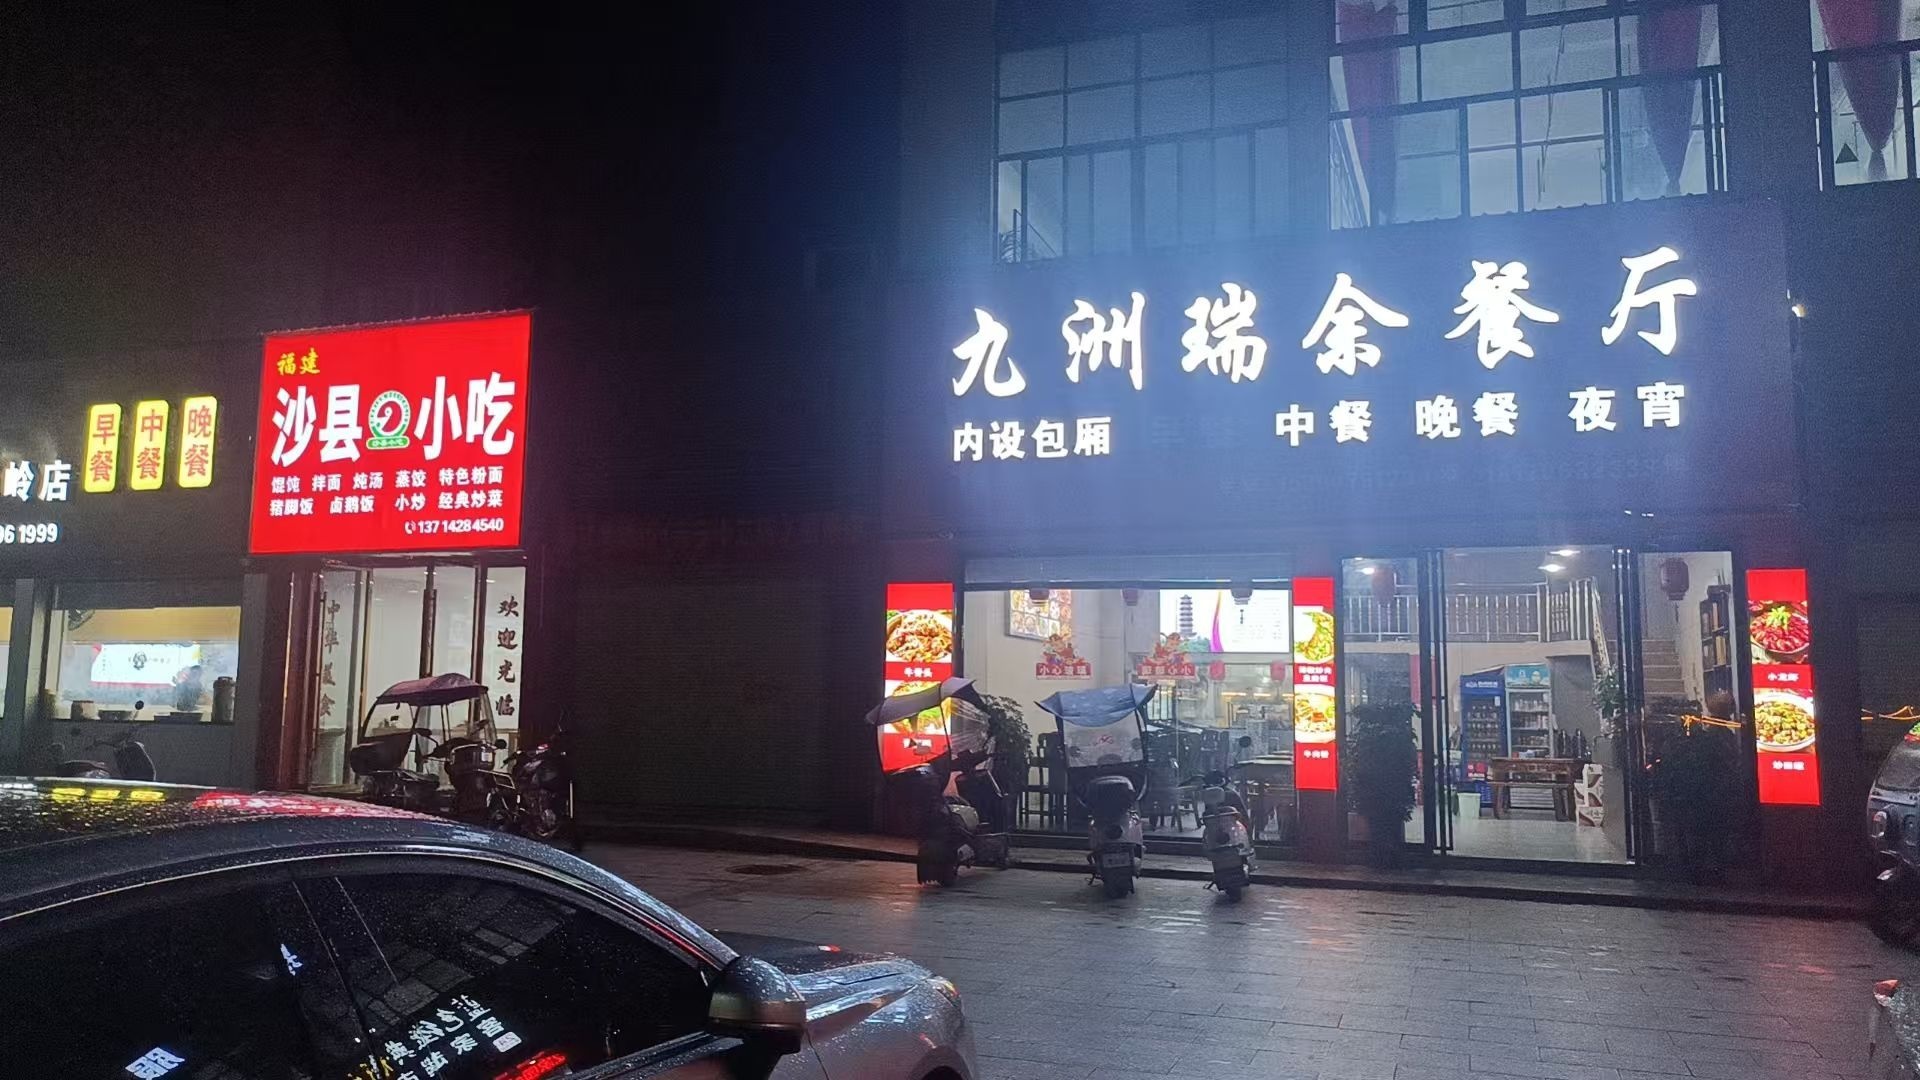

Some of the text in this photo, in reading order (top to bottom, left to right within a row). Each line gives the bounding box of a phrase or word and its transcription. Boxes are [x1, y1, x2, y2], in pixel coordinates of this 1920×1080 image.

[952, 246, 1698, 398] 九洲瑞余餐厅
[277, 348, 320, 376] 福建
[136, 408, 163, 480] 中餐
[184, 405, 213, 477] 晚餐
[271, 371, 516, 467] 沙县 小吃
[953, 416, 1112, 462] 内设包厢
[1275, 381, 1686, 447] 中餐 晚餐 夜宵
[3, 459, 72, 502] 岭店
[89, 413, 116, 483] 早餐
[312, 473, 342, 492] 拌面
[353, 471, 384, 490] 炖汤
[395, 469, 426, 488] 蒸饺
[439, 466, 504, 486] 特色粉面
[18, 522, 59, 544] 1999
[269, 489, 503, 516] 猪脚饭 卤鹅饭 小炒 经典炒菜
[496, 595, 520, 717] 欢迎光临
